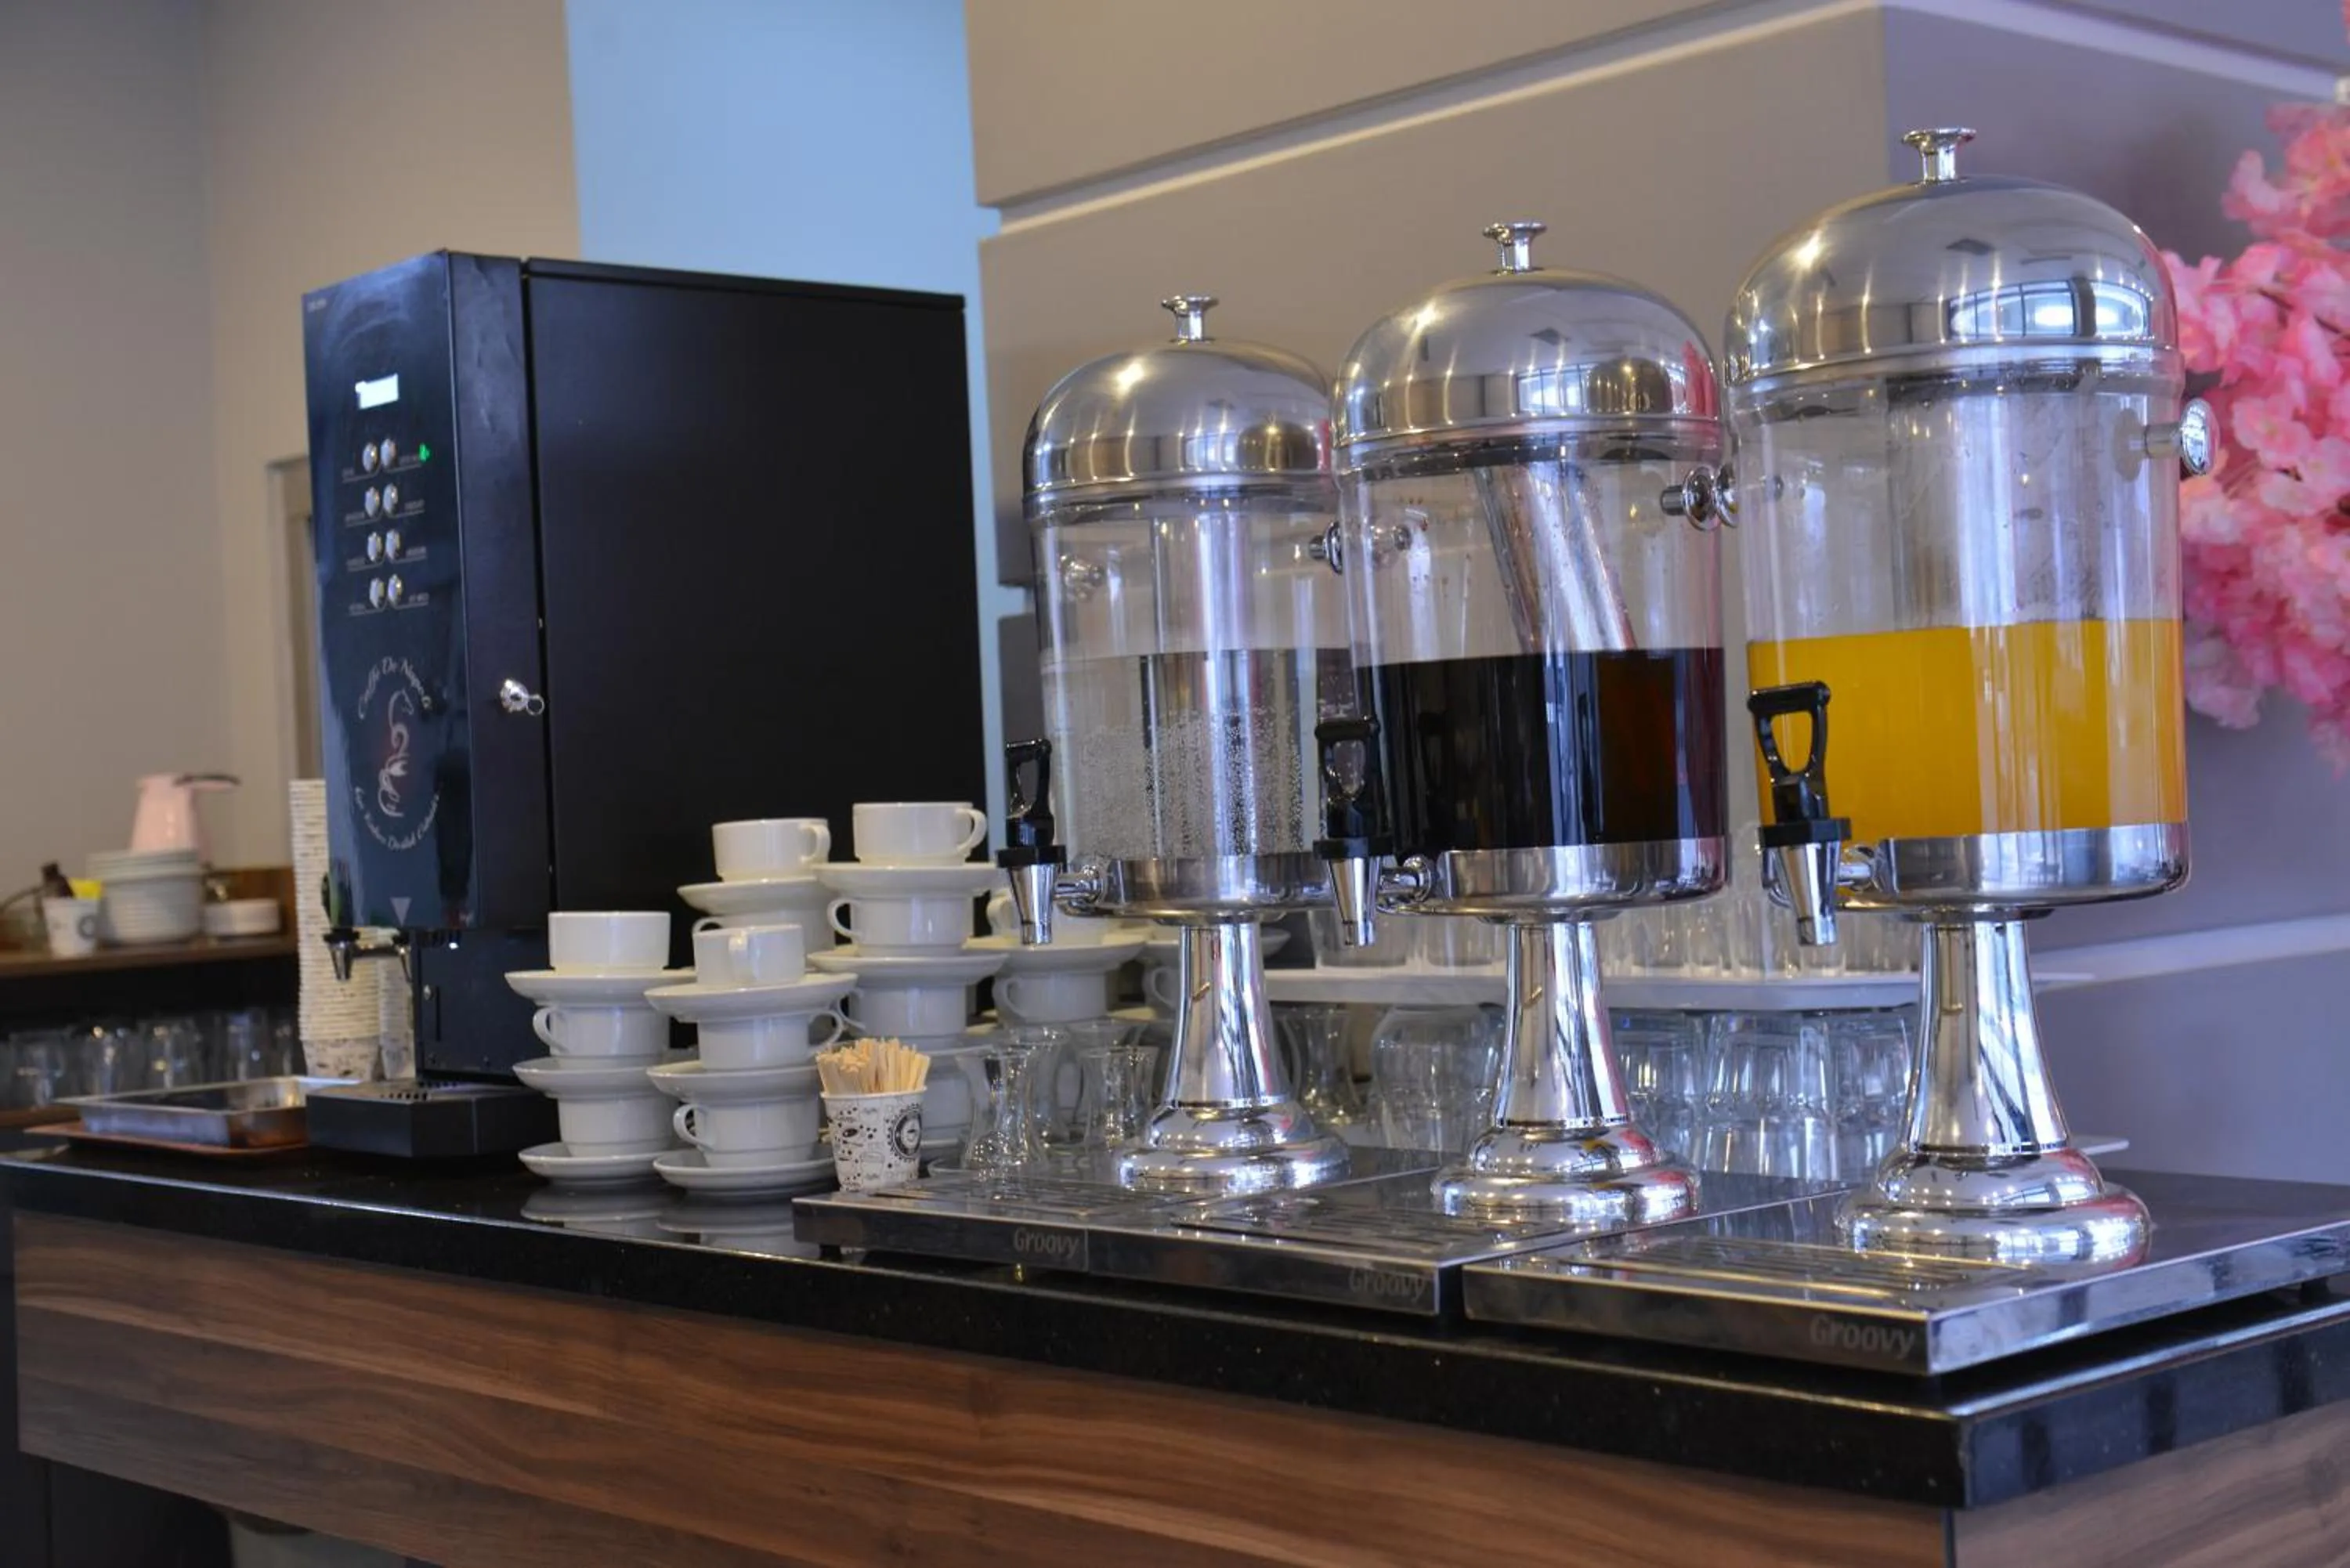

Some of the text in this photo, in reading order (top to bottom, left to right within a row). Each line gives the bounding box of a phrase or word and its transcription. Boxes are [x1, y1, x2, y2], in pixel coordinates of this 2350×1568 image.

[1013, 1226, 1080, 1259] Groovy
[1349, 1266, 1426, 1303] Groovy
[1809, 1312, 1916, 1360] Groovy
